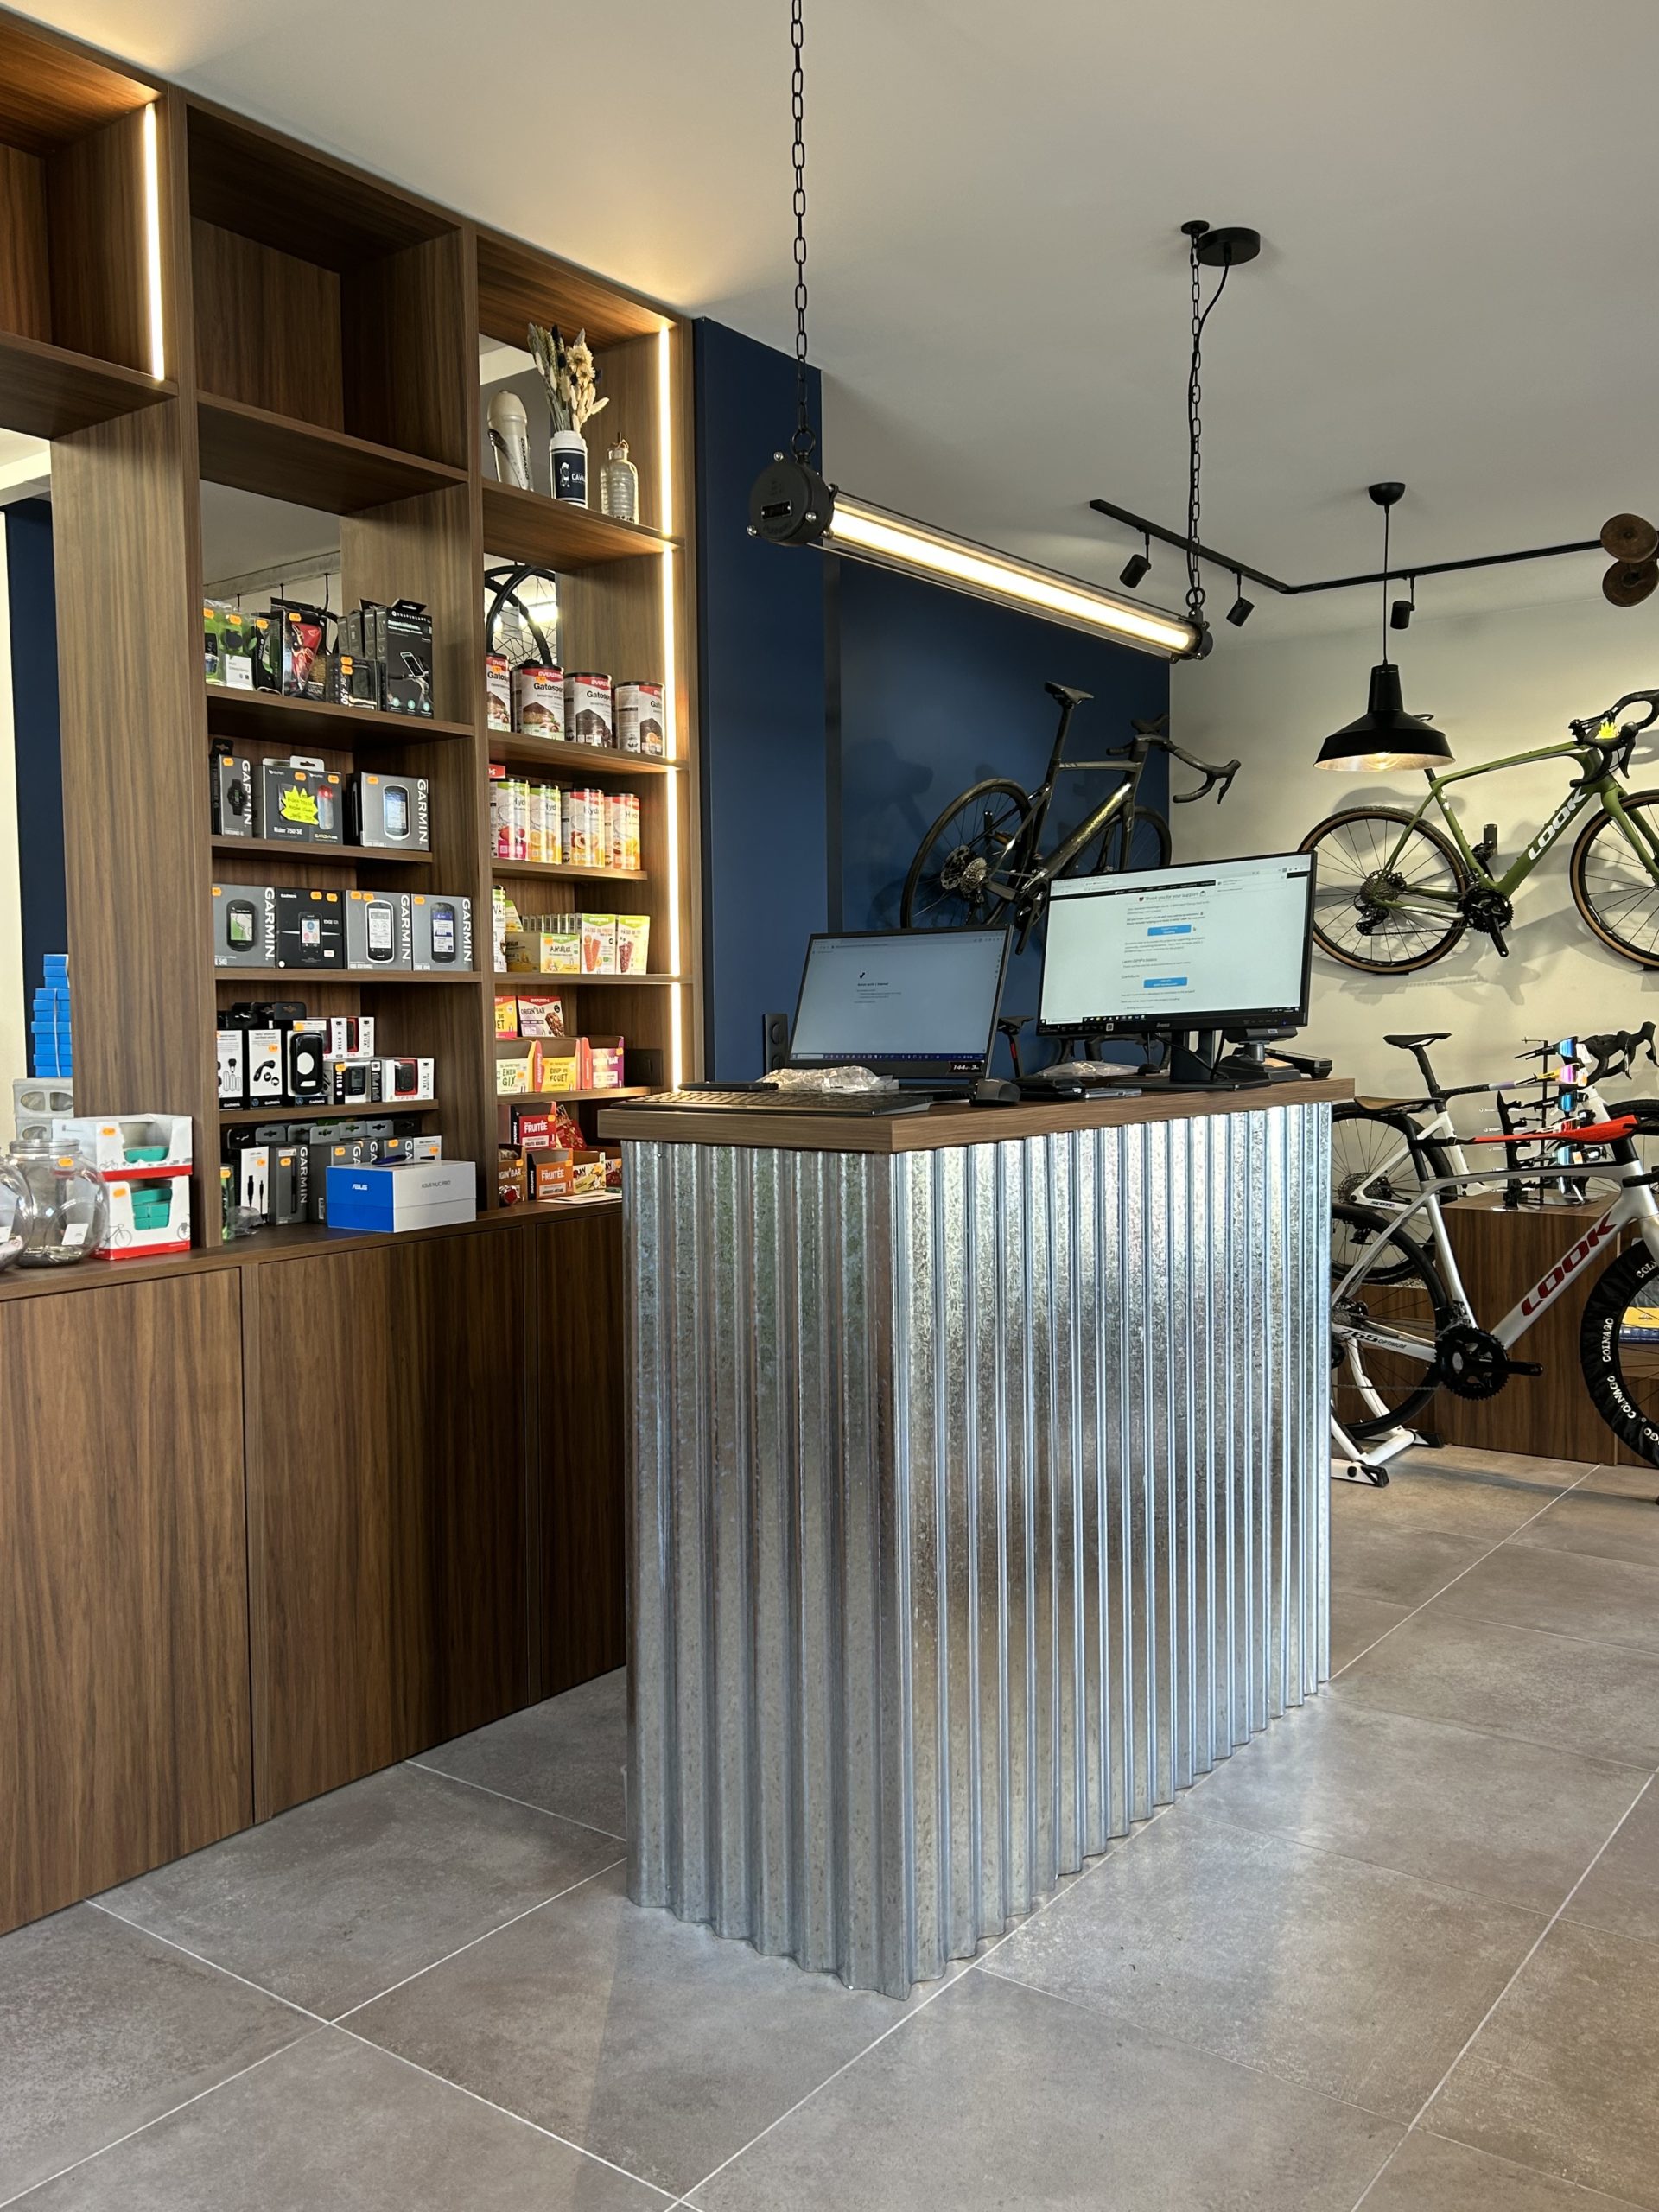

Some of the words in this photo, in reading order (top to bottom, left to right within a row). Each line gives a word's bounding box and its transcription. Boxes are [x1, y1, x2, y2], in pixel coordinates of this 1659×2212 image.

[416, 779, 428, 842] GARMIN
[1527, 785, 1588, 861] LOOK
[264, 887, 275, 958] GARMIN
[400, 894, 410, 960] GARMIN
[461, 898, 472, 962] GARMIN
[524, 1120, 548, 1134] FRUITÉE
[541, 1167, 565, 1181] FRUITÉE
[1521, 1212, 1617, 1318] LOOK
[1377, 1338, 1408, 1349] OPTIMUM
[1602, 1317, 1615, 1363] COLNAGO
[1607, 1376, 1637, 1420] COLNAGO
